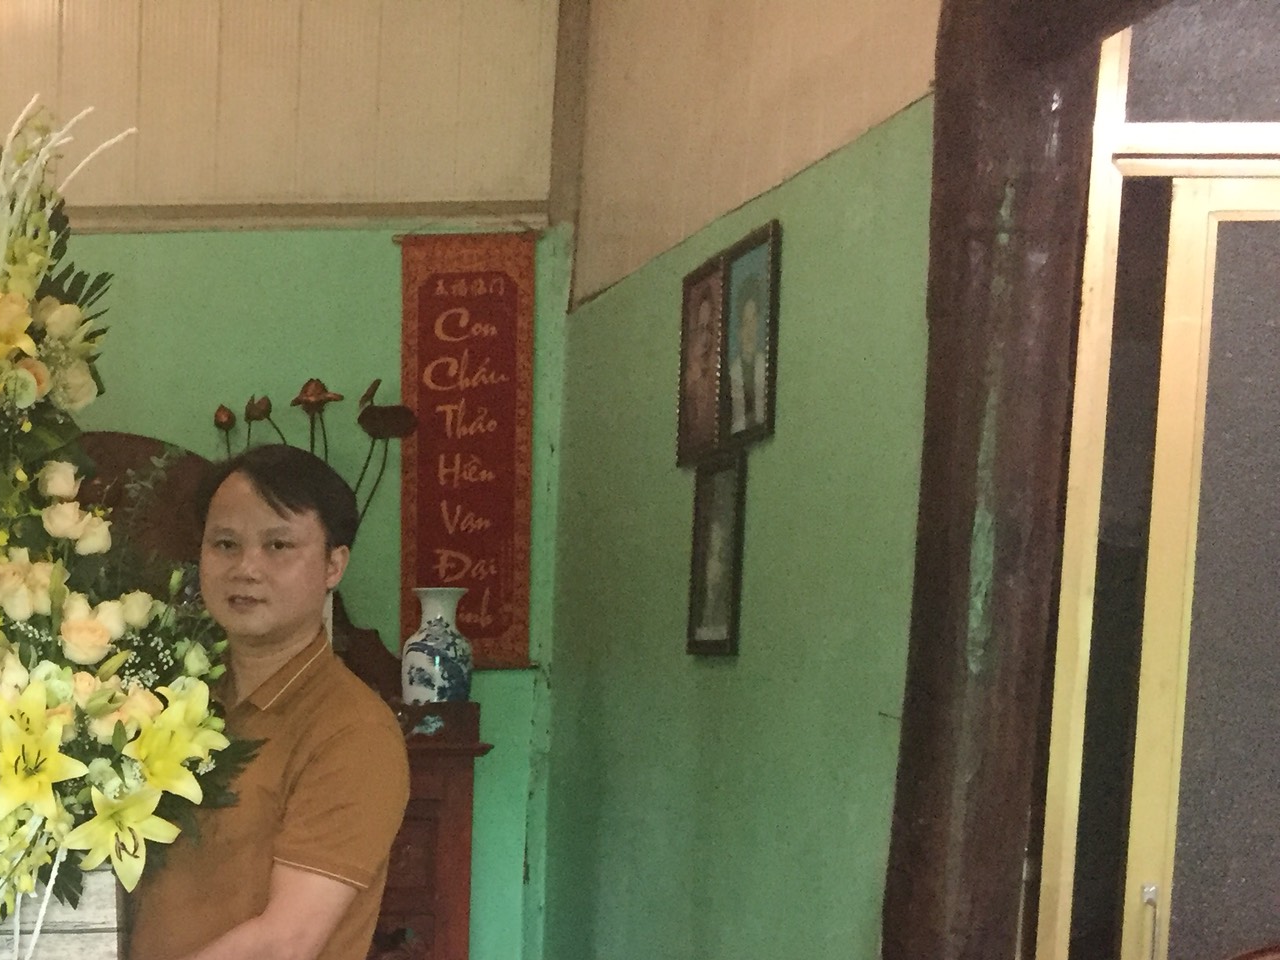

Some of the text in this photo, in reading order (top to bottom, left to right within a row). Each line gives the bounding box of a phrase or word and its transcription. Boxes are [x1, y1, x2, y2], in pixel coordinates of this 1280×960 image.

[434, 306, 498, 342] Con
[423, 348, 511, 391] Cháu
[436, 397, 498, 439] Thảo
[438, 453, 496, 488] Hiền
[433, 549, 498, 583] Đại
[458, 587, 492, 628] inh
